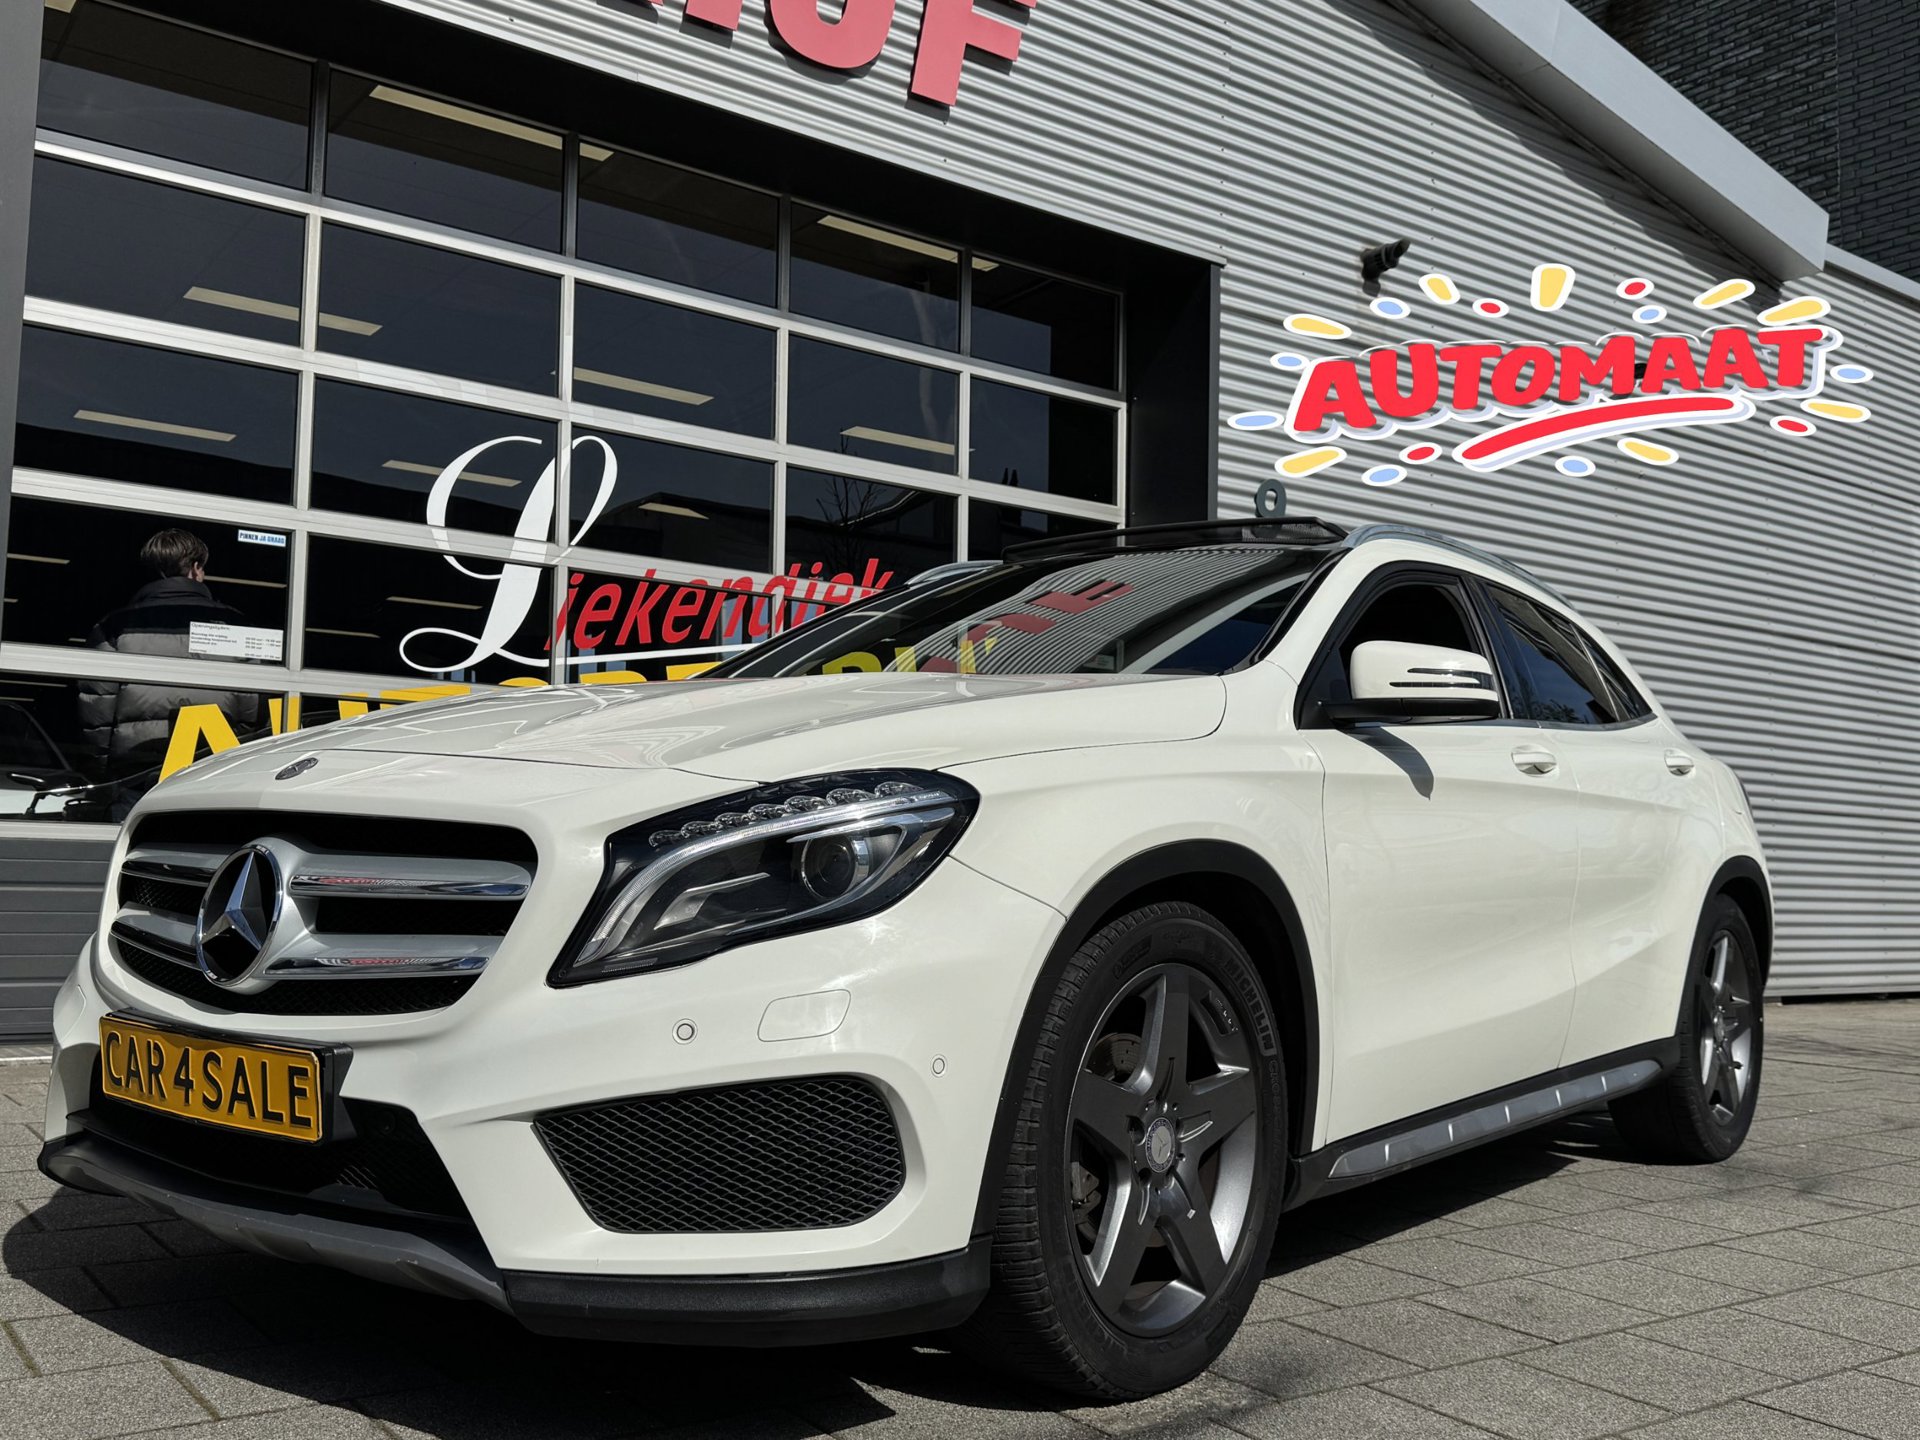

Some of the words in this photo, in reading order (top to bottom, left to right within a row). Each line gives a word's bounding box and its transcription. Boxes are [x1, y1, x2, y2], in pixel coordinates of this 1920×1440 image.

[239, 531, 259, 541] PINNEN
[1221, 960, 1276, 1051] MICHELIN
[106, 1030, 167, 1100] CAR
[174, 1047, 194, 1106] 4
[203, 1051, 313, 1127] SALE
